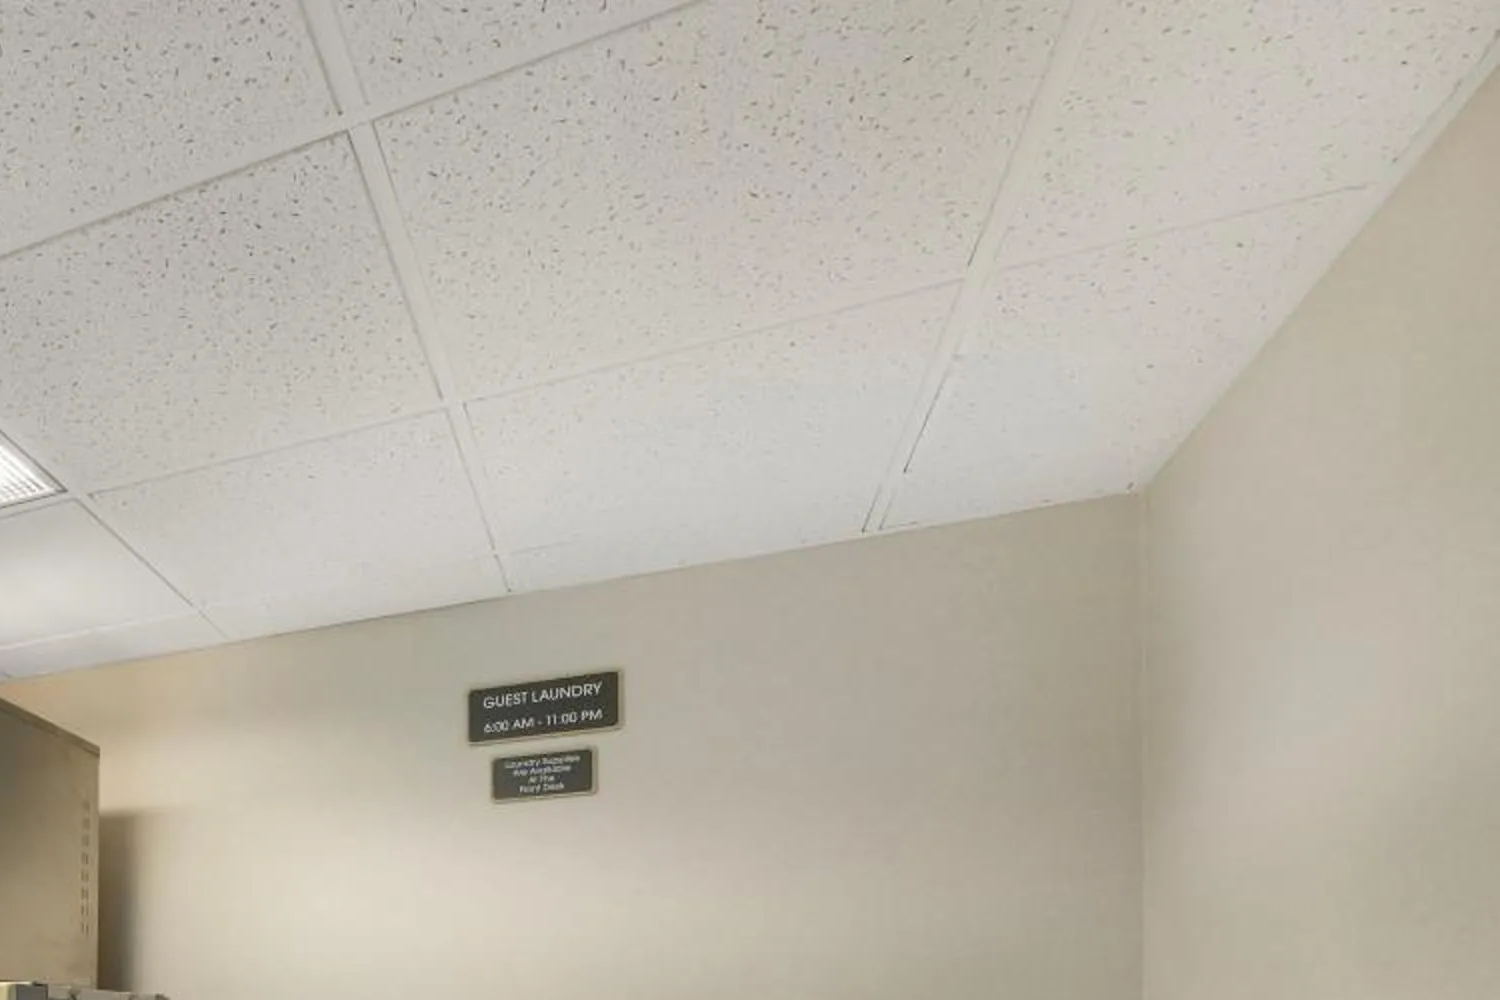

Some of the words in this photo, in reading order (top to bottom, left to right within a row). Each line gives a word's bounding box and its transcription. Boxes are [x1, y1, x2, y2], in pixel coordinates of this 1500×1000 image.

[483, 691, 528, 709] GUEST
[531, 681, 603, 703] LAUNDRY
[483, 719, 510, 734] 6:00
[513, 717, 535, 729] AM
[581, 709, 603, 722] PM
